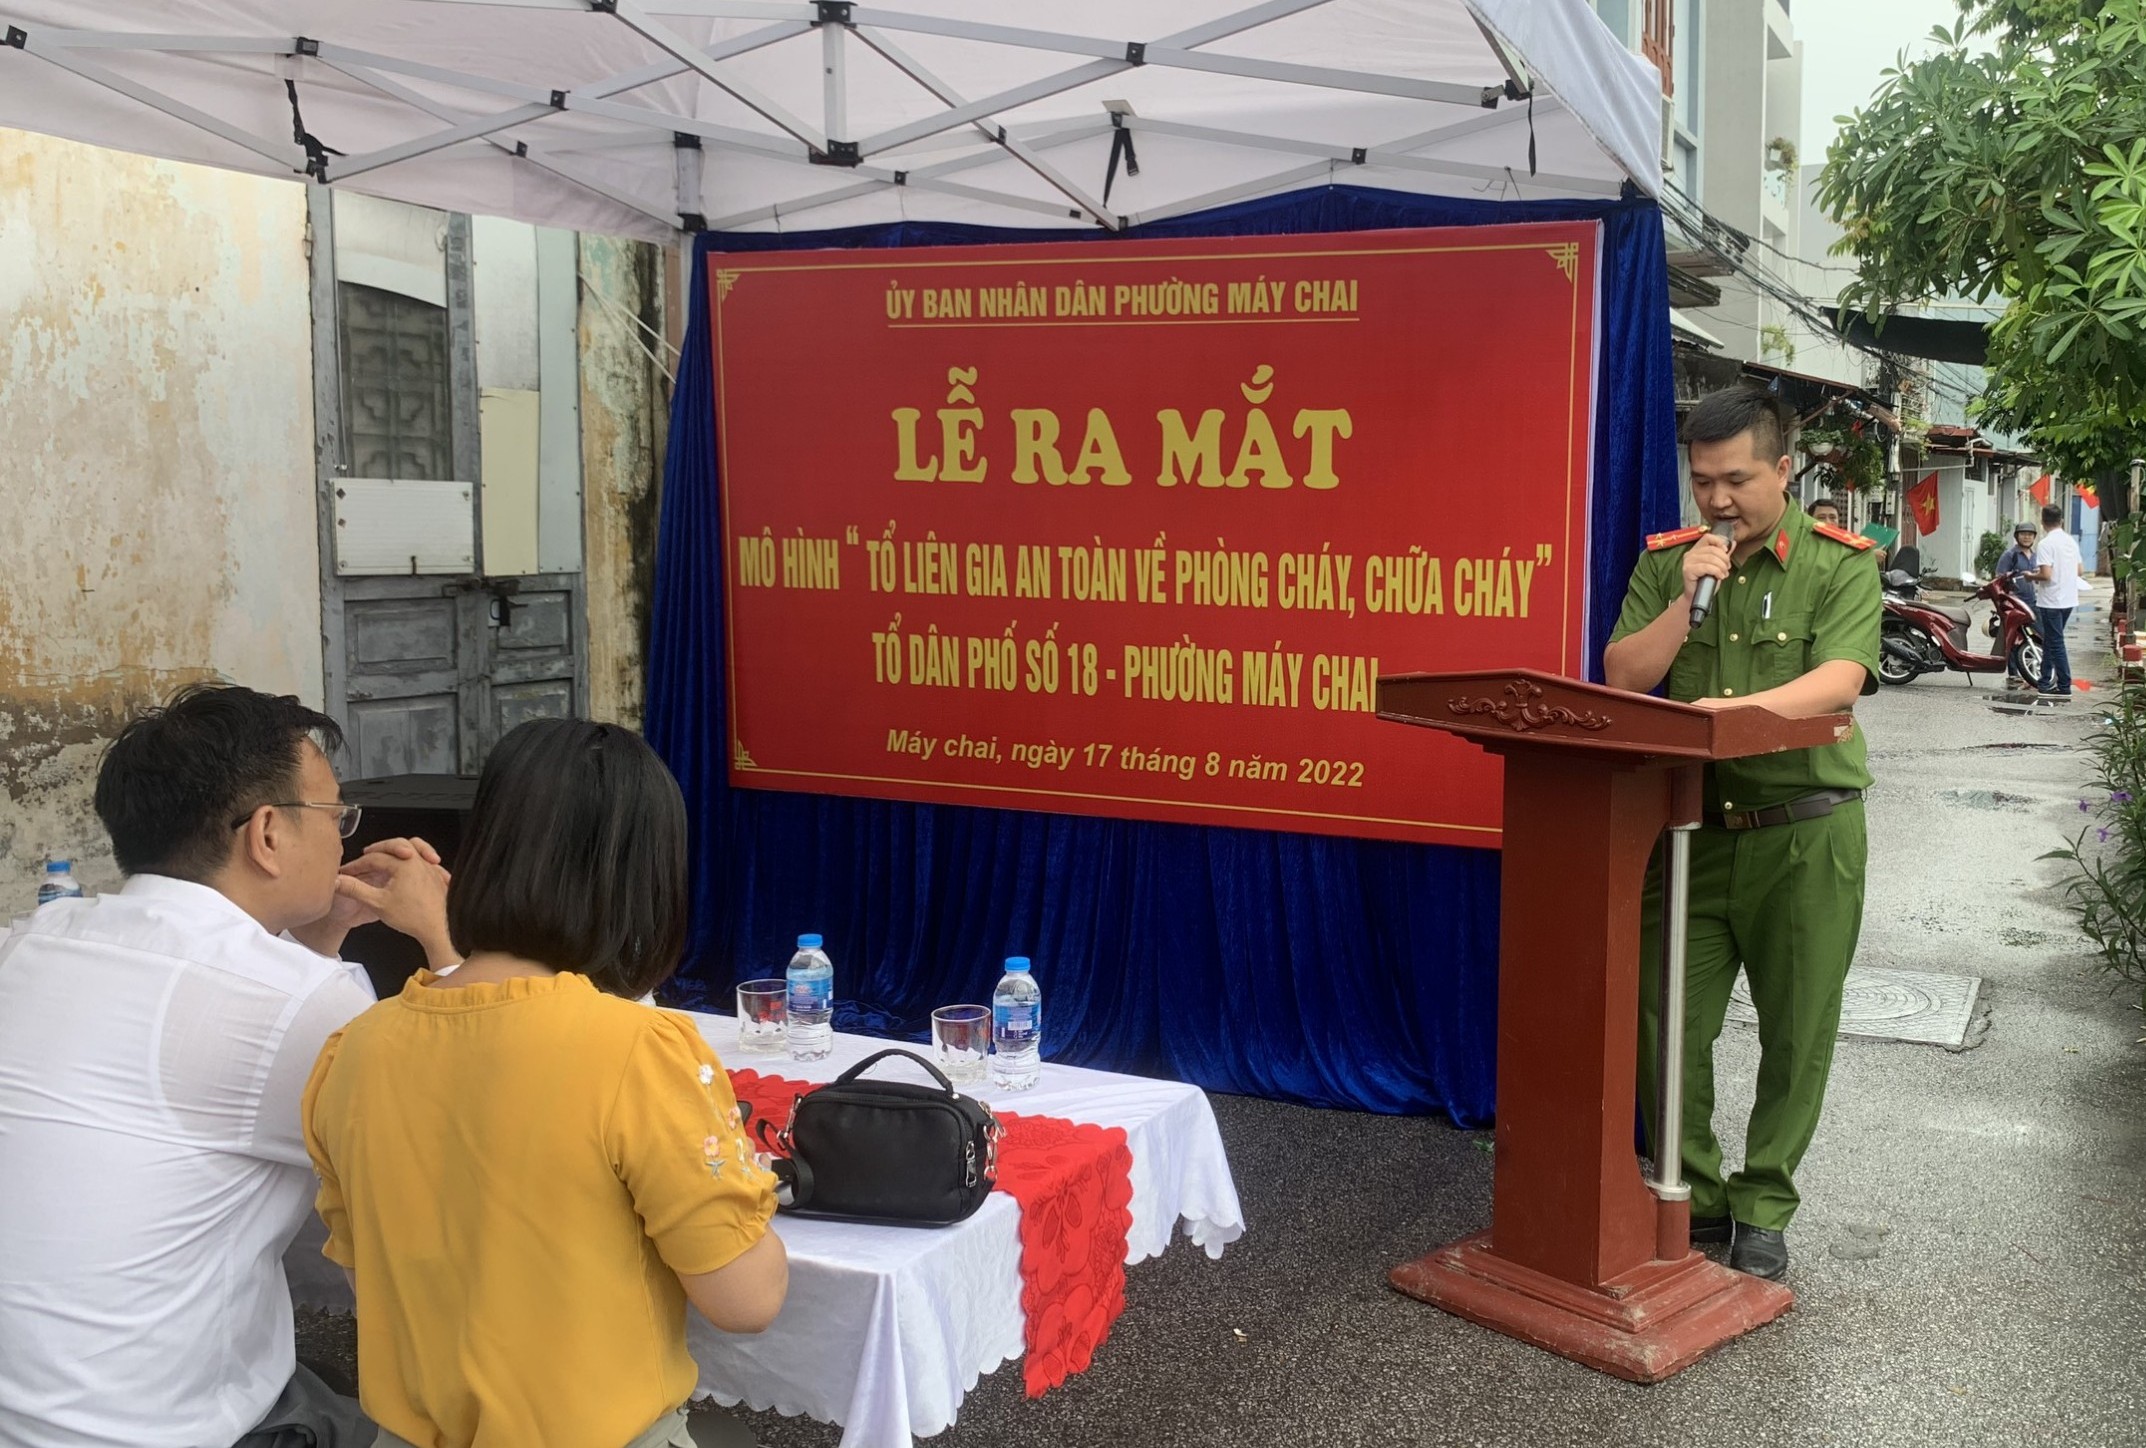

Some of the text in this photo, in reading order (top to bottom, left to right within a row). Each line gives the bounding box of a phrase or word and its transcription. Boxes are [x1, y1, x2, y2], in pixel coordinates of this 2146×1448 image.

[886, 275, 1357, 319] ỦY BAN NHÂN DÂN PHƯỜNG MÁY CHAI
[892, 365, 1352, 489] LỄ RA MẮT
[739, 527, 775, 587] MÔ
[783, 527, 839, 589] HÌNH
[904, 531, 957, 594] LIÊN
[966, 543, 1008, 596] GIA
[1016, 545, 1050, 598] AN
[1058, 536, 1126, 601] TOÀN
[1135, 531, 1166, 603] VỀ
[1176, 537, 1268, 608] PHÒNG
[1278, 542, 1355, 618] CHÁY,
[1366, 545, 1444, 615] CHỮA
[1454, 544, 1552, 618] CHÁY”
[872, 612, 901, 684] TỔ
[909, 624, 959, 687] DÂN
[968, 620, 1017, 691] PHỐ
[1026, 622, 1059, 693] SỐ
[1068, 643, 1097, 696] 18
[1125, 634, 1233, 704] PHƯỜNG
[1243, 640, 1303, 707] MÁY
[1313, 654, 1378, 712] CHAI
[887, 730, 1364, 786] Máy chai, ngày 17 tháng 8 năm 2022
